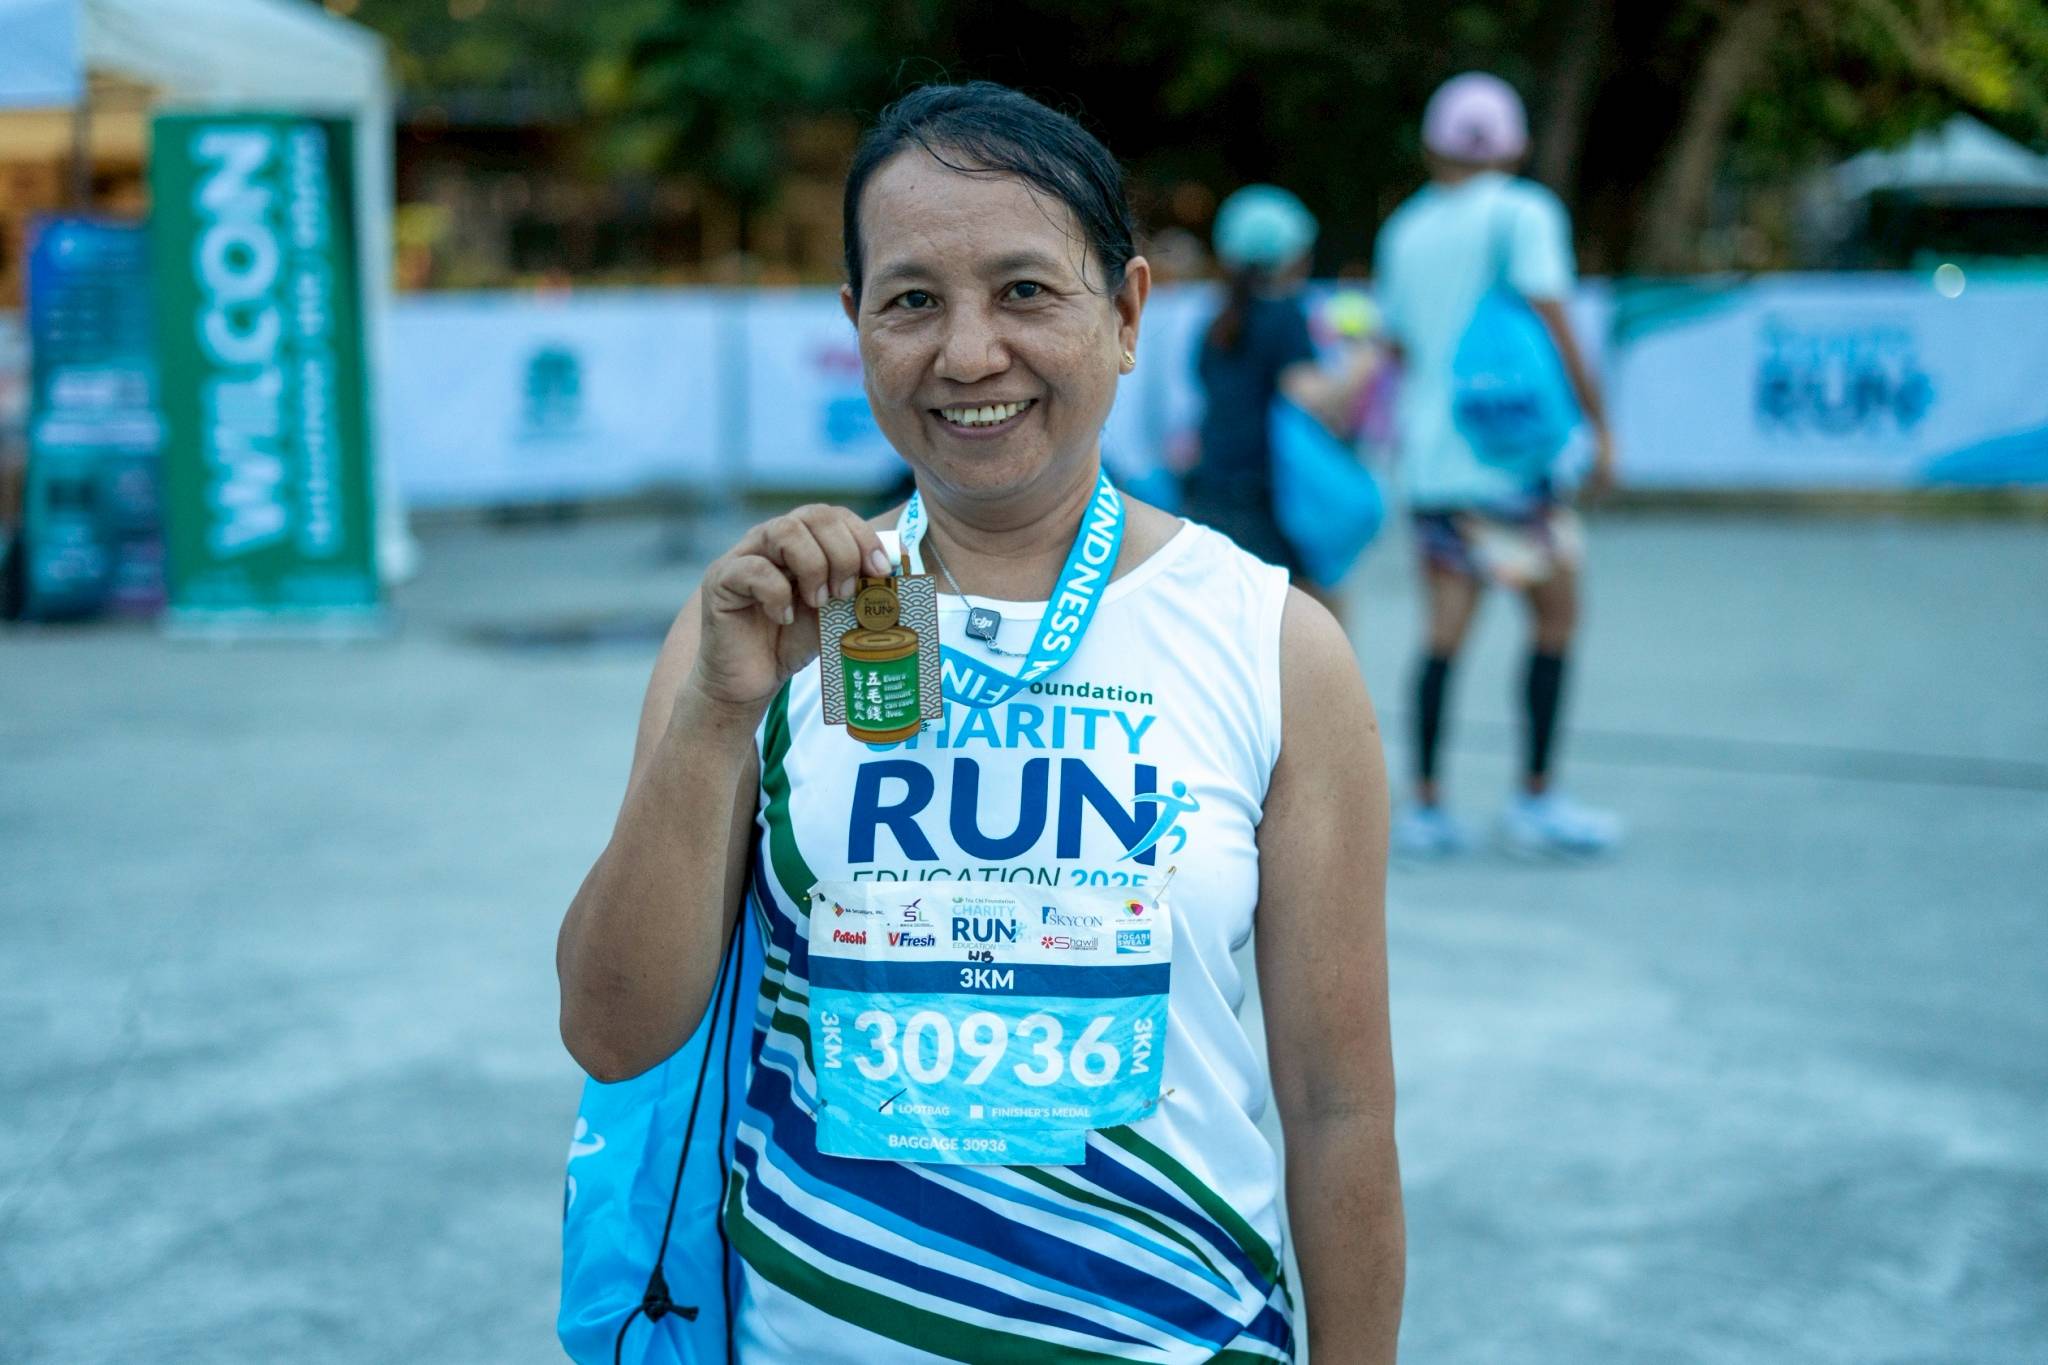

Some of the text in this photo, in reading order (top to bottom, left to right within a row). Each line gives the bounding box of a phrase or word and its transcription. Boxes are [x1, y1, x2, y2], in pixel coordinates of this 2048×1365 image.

[1042, 475, 1120, 653] KINDNESS
[1030, 680, 1154, 705] oundation
[865, 702, 1157, 754] HARITY
[848, 757, 1158, 866] RUN
[952, 904, 1016, 917] CHARITY
[1049, 914, 1103, 928] SKYCON
[952, 916, 1017, 943] RUN
[1118, 933, 1150, 941] POCARI
[952, 942, 997, 950] EDUCATION
[960, 967, 1015, 990] 3KM
[820, 1010, 843, 1069] 3KM
[854, 1010, 1121, 1088] 30936
[1130, 1017, 1154, 1074] 3KM
[899, 1104, 950, 1116] LOOTBAG
[992, 1107, 1091, 1119] FINISHER'S MEDAL
[888, 1134, 1007, 1153] BAGGAGE 30936
